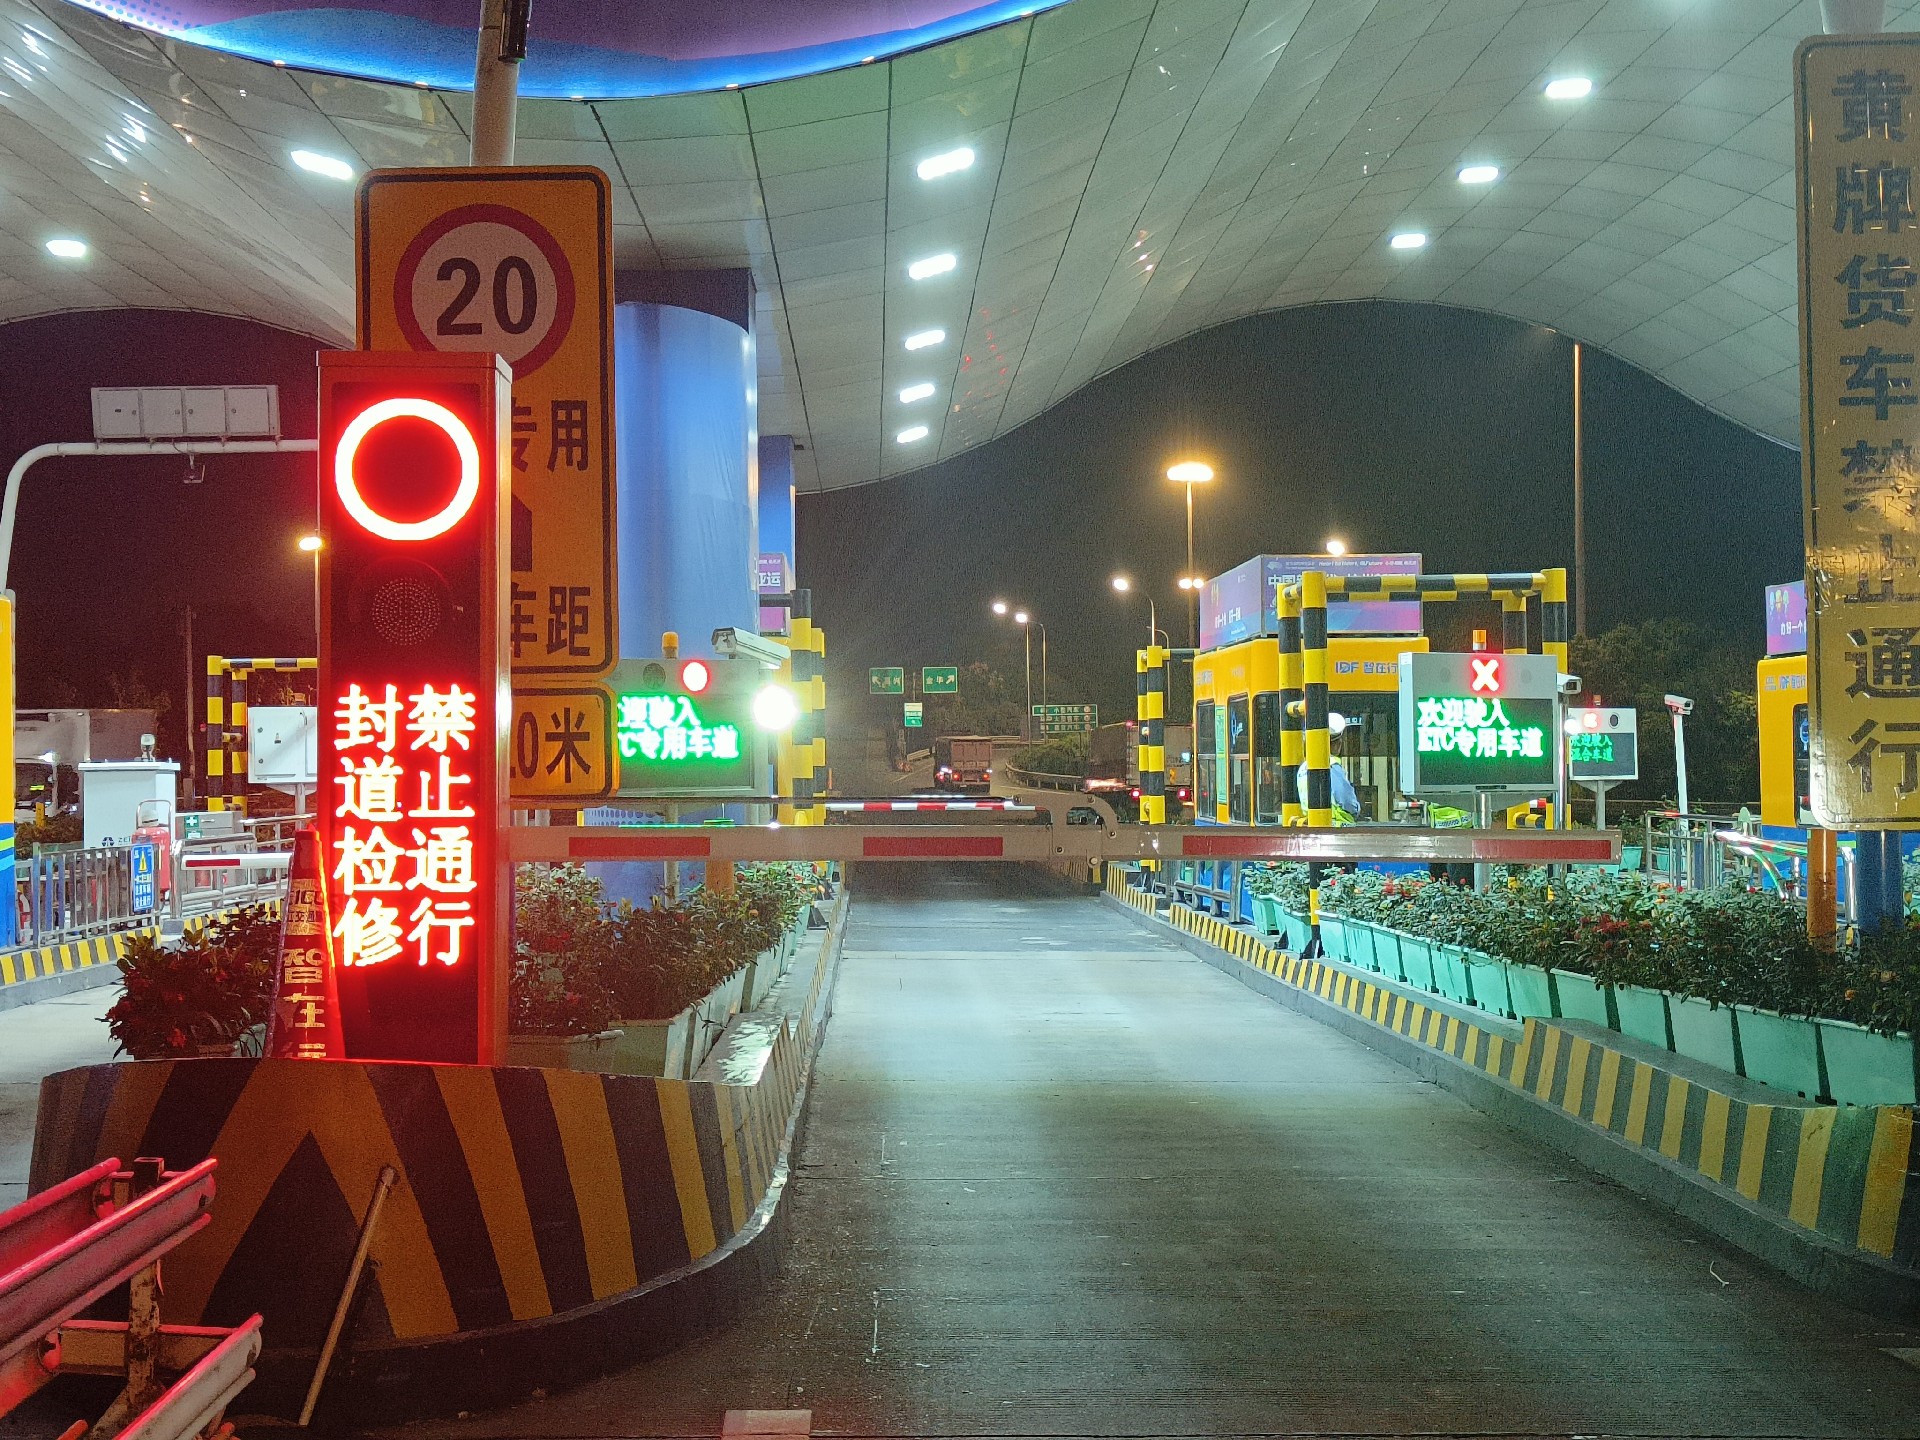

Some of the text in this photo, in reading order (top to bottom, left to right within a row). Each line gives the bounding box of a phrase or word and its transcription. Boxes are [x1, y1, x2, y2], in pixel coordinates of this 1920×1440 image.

[437, 256, 537, 336] 20
[1831, 69, 1919, 794] 黄牌货车禁止通行
[510, 707, 592, 783] 0米
[1417, 697, 1511, 728] 欢迎驶入
[1417, 726, 1544, 758] ETC专用车道
[333, 684, 405, 967] 封道检修
[405, 684, 477, 967] 禁止通行
